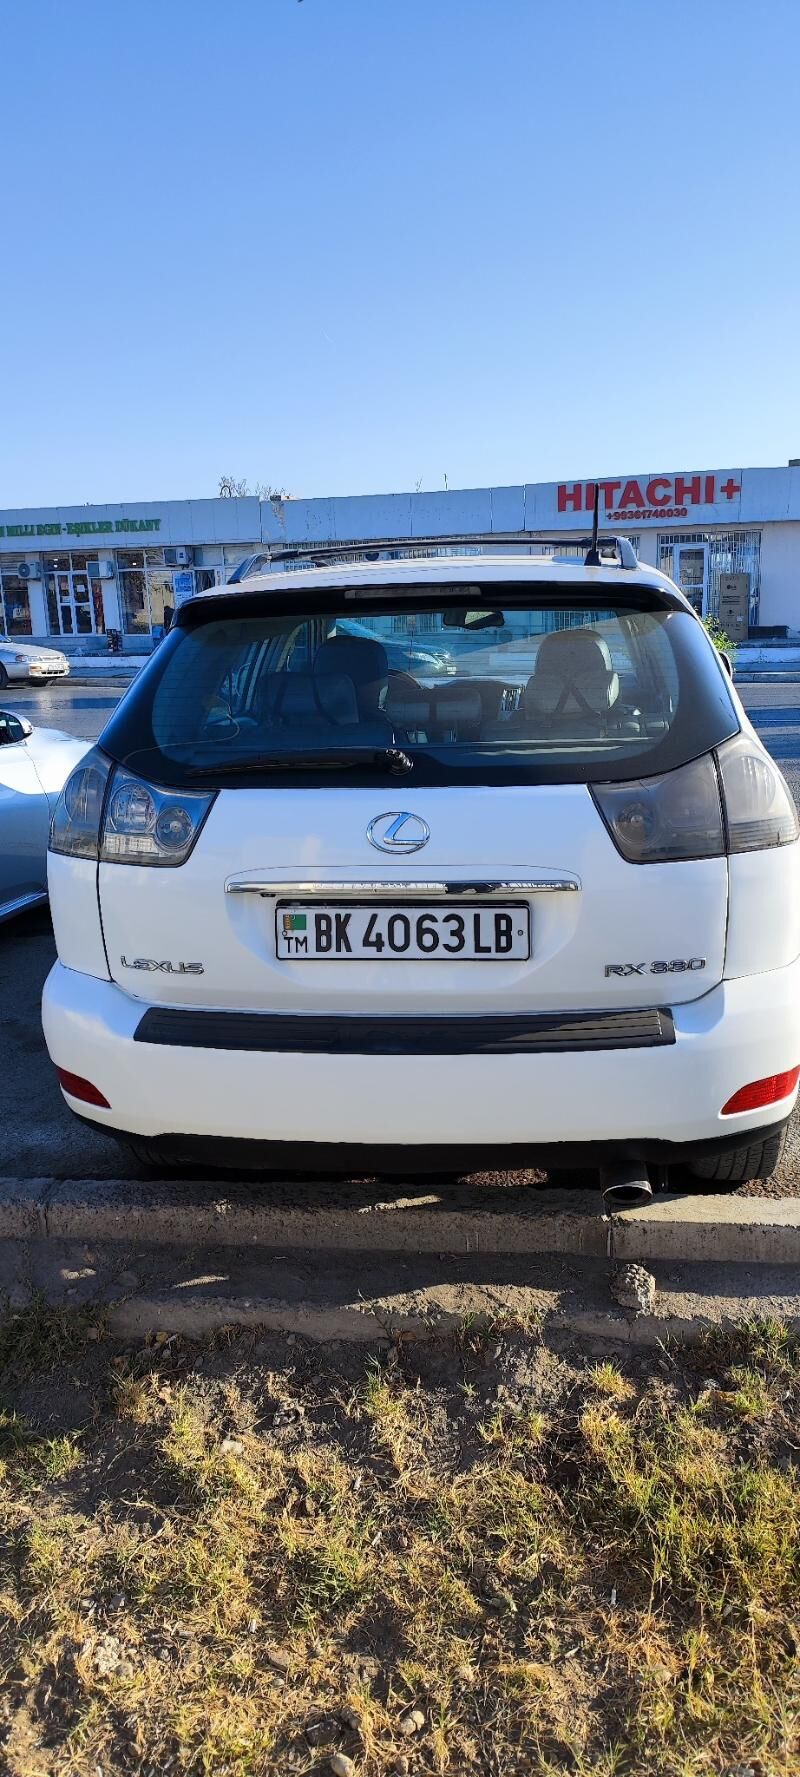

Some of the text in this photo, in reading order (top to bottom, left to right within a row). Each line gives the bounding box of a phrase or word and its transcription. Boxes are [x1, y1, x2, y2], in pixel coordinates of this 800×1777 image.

[284, 913, 512, 953] TM BK 4063 LB
[120, 956, 205, 975] LEXUS
[604, 957, 706, 977] RX 330
